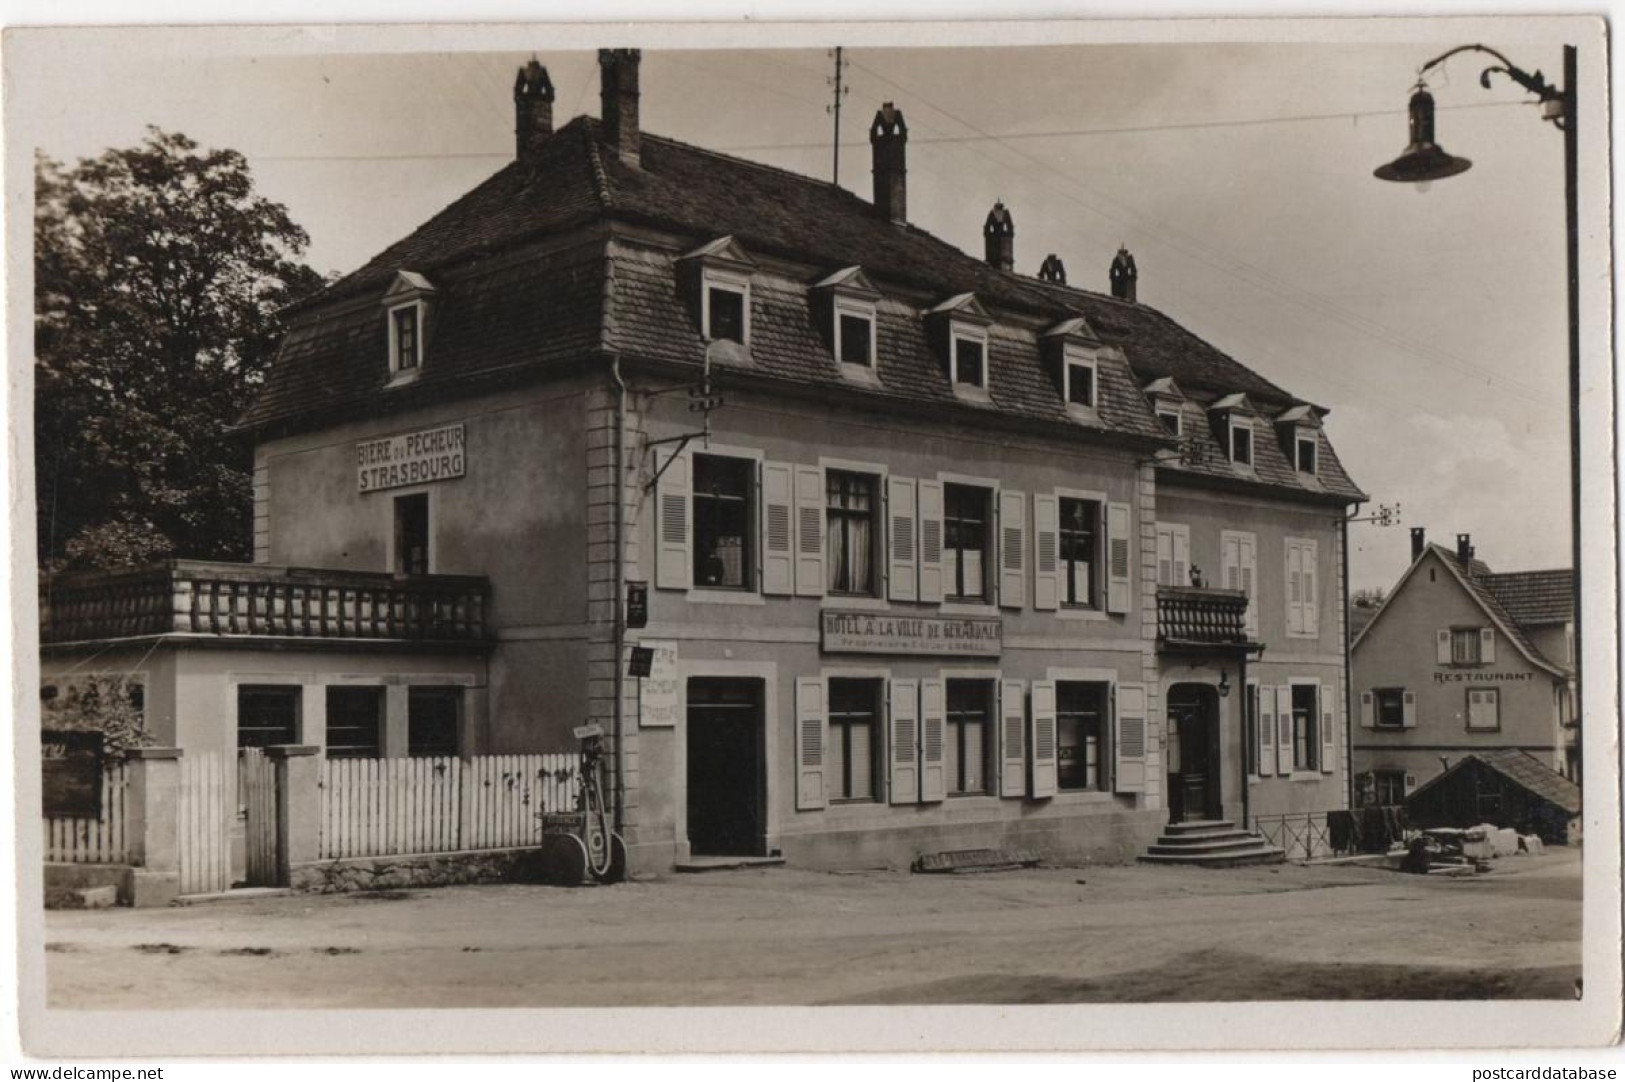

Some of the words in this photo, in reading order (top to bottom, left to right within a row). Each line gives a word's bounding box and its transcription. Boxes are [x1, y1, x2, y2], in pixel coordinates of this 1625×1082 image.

[360, 454, 462, 489] STRASBOURG
[879, 620, 893, 636] LA
[896, 620, 922, 638] VILLE
[928, 623, 939, 639] DE
[1433, 672, 1534, 683] RESTAURANT
